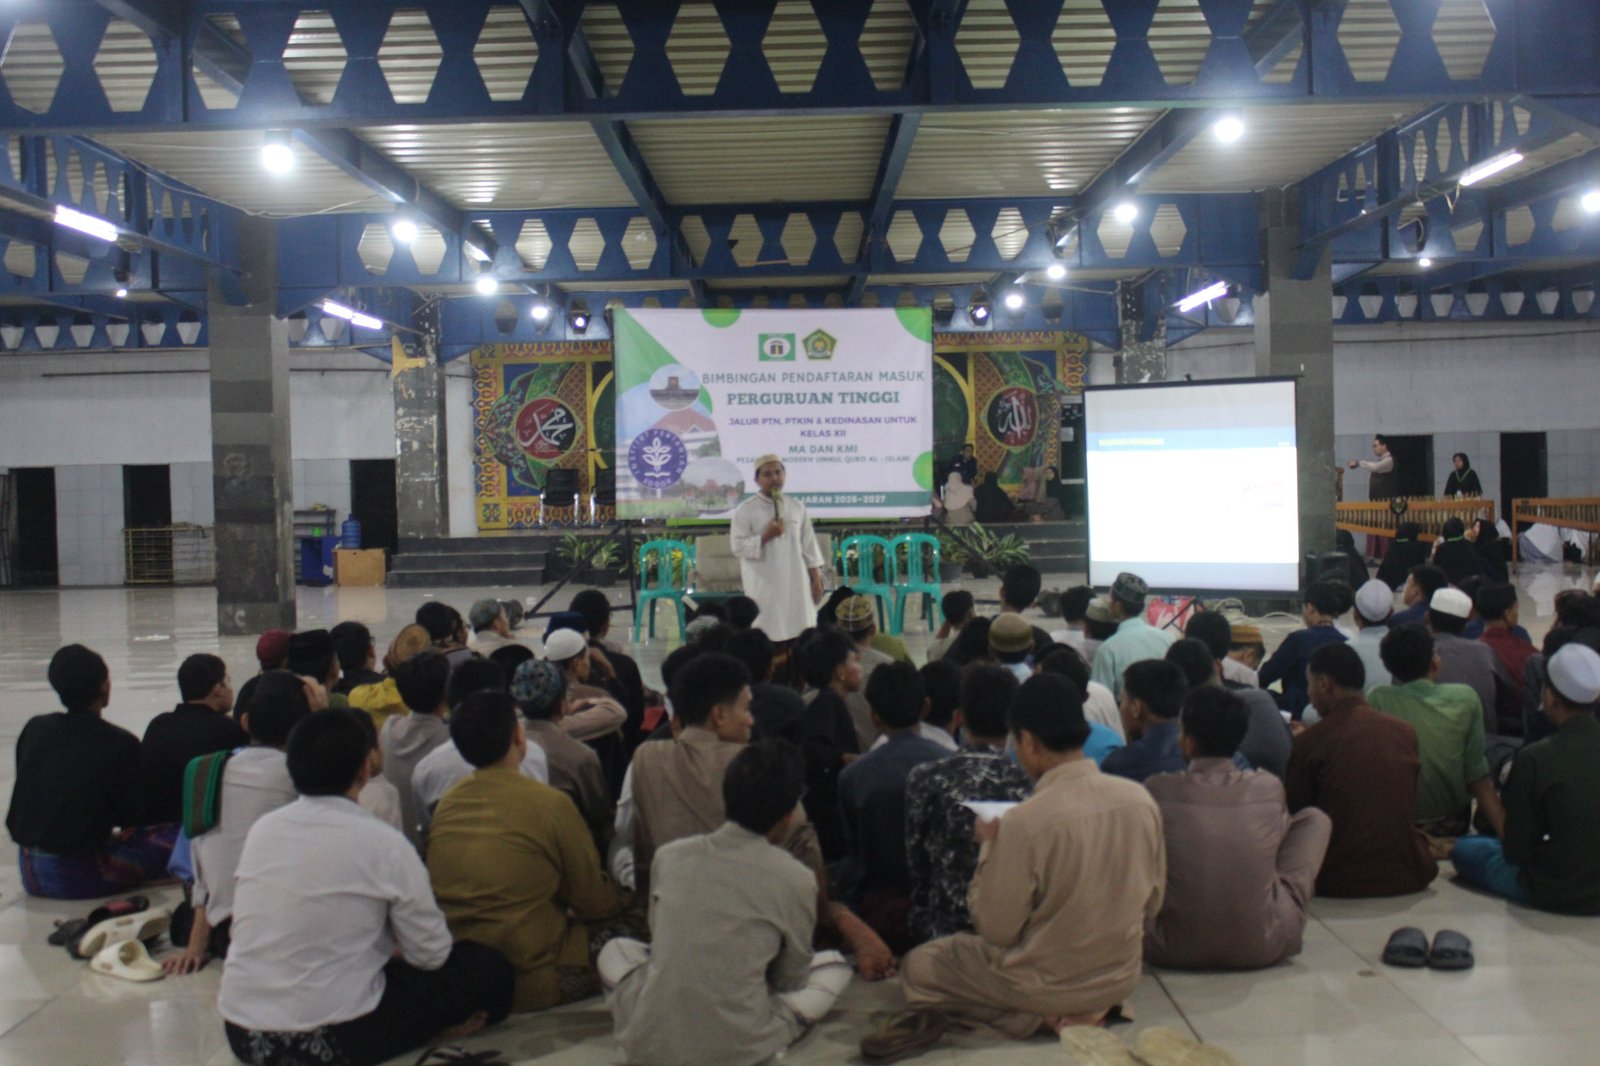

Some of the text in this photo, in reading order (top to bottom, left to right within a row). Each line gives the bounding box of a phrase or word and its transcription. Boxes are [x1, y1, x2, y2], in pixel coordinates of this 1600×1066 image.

[702, 370, 925, 384] BIMBINGAN PENDAFTARAN MASUK
[726, 391, 900, 406] PERGURUAN TINGGI
[728, 417, 760, 426] JALUR
[785, 417, 814, 425] PTKIN
[815, 417, 823, 425] &
[825, 416, 882, 425] KEDINASAN
[884, 416, 918, 424] UNTUK
[800, 430, 847, 438] KELAS XII
[788, 444, 858, 454] MA DAN KMI
